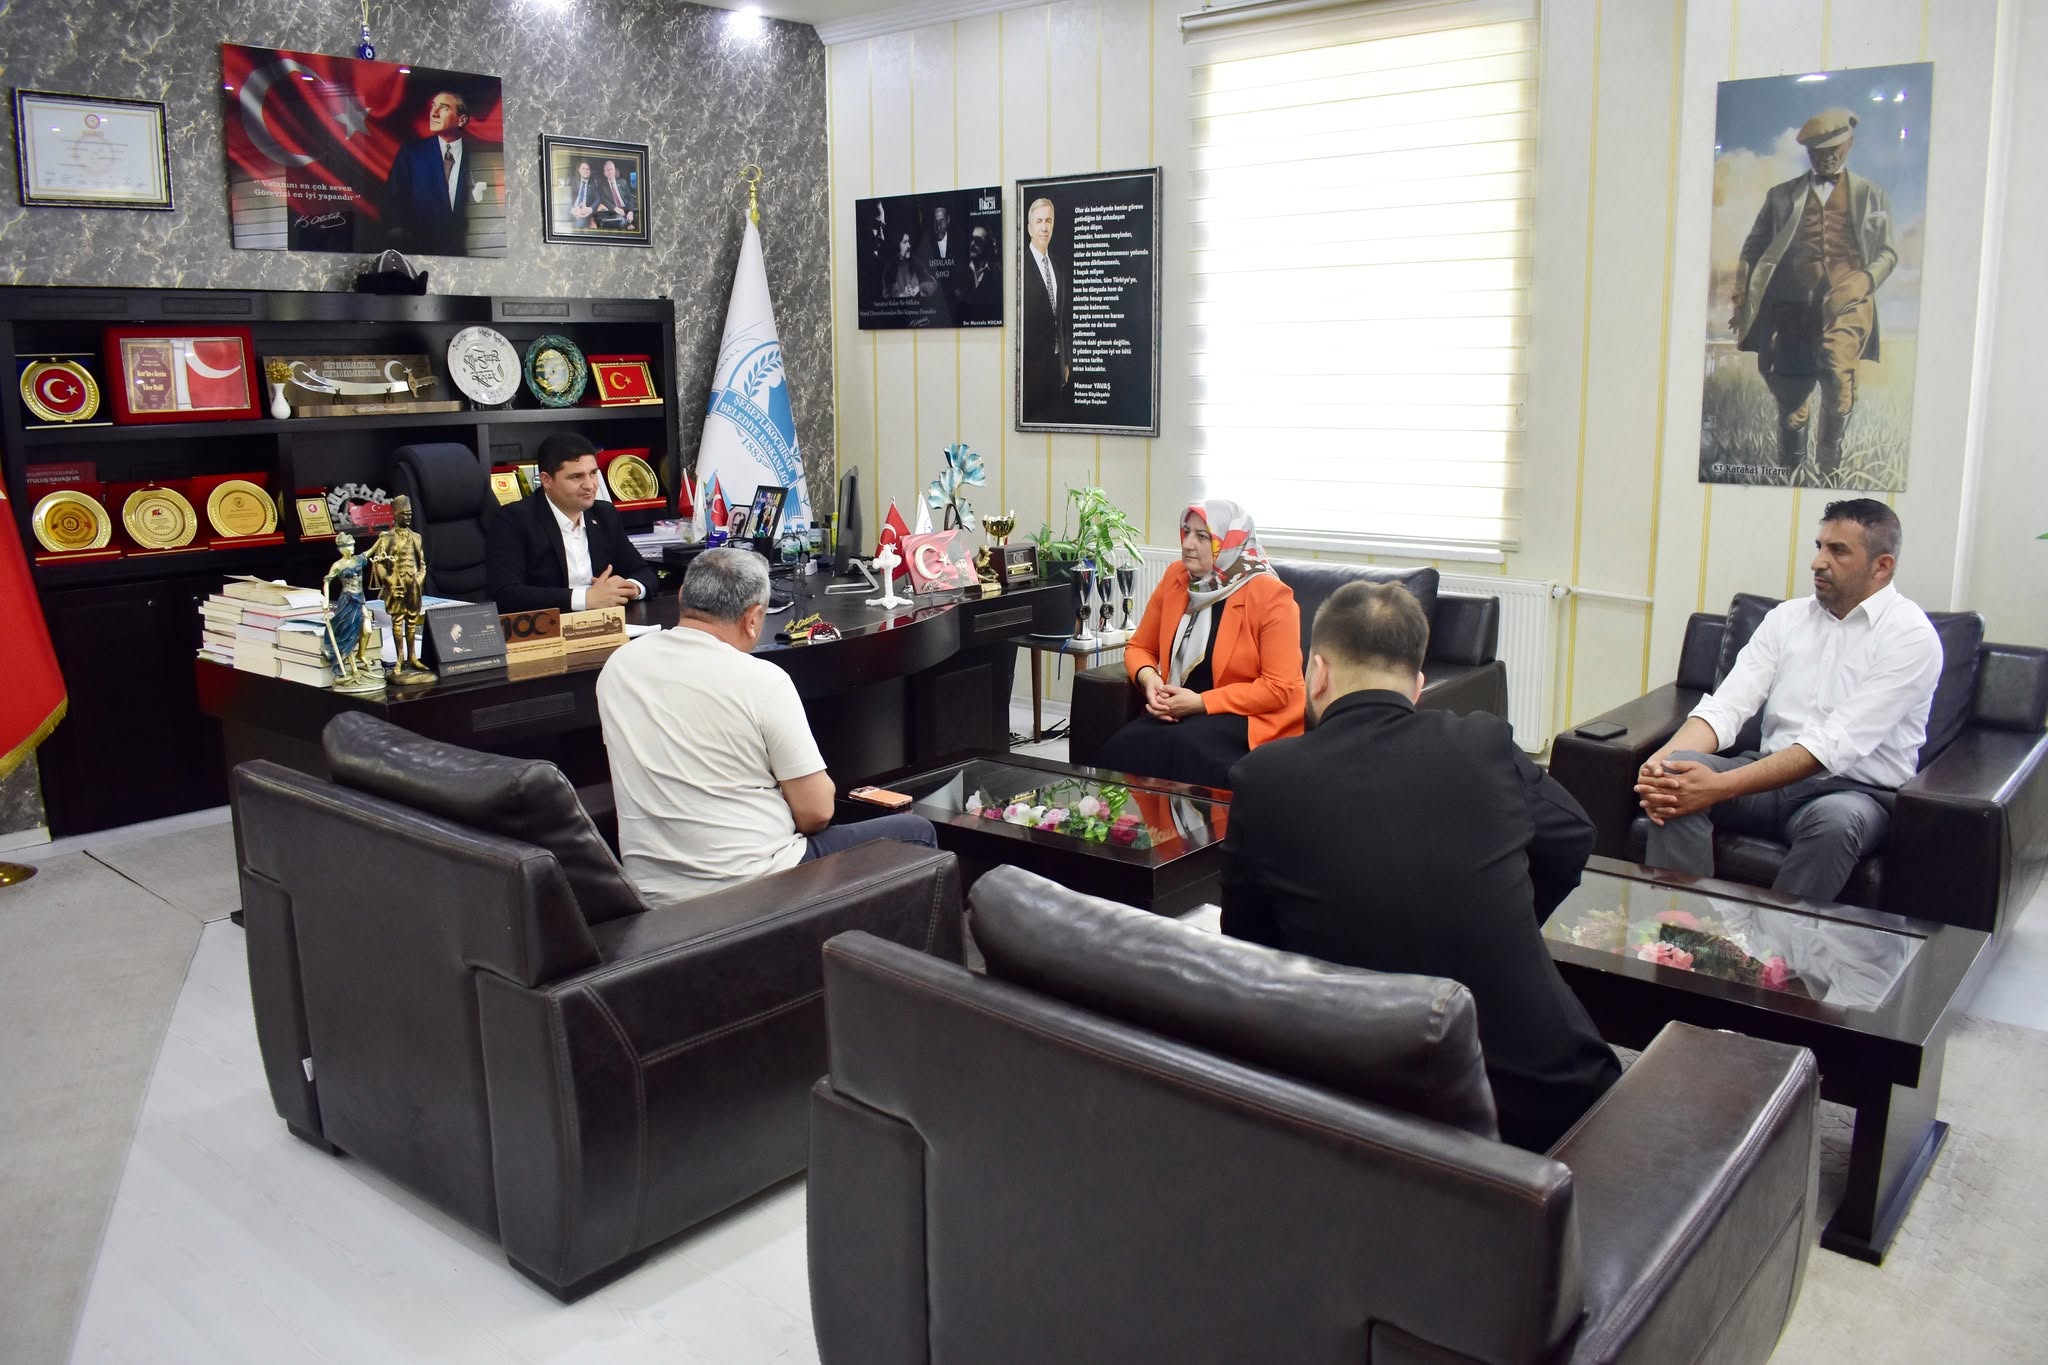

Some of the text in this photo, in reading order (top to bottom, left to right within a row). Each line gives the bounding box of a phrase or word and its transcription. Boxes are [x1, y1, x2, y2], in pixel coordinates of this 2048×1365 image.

[318, 193, 353, 201] yapandır
[720, 402, 760, 437] BELEDİYE
[741, 437, 763, 463] 1885
[1762, 466, 1789, 476] Ticaret
